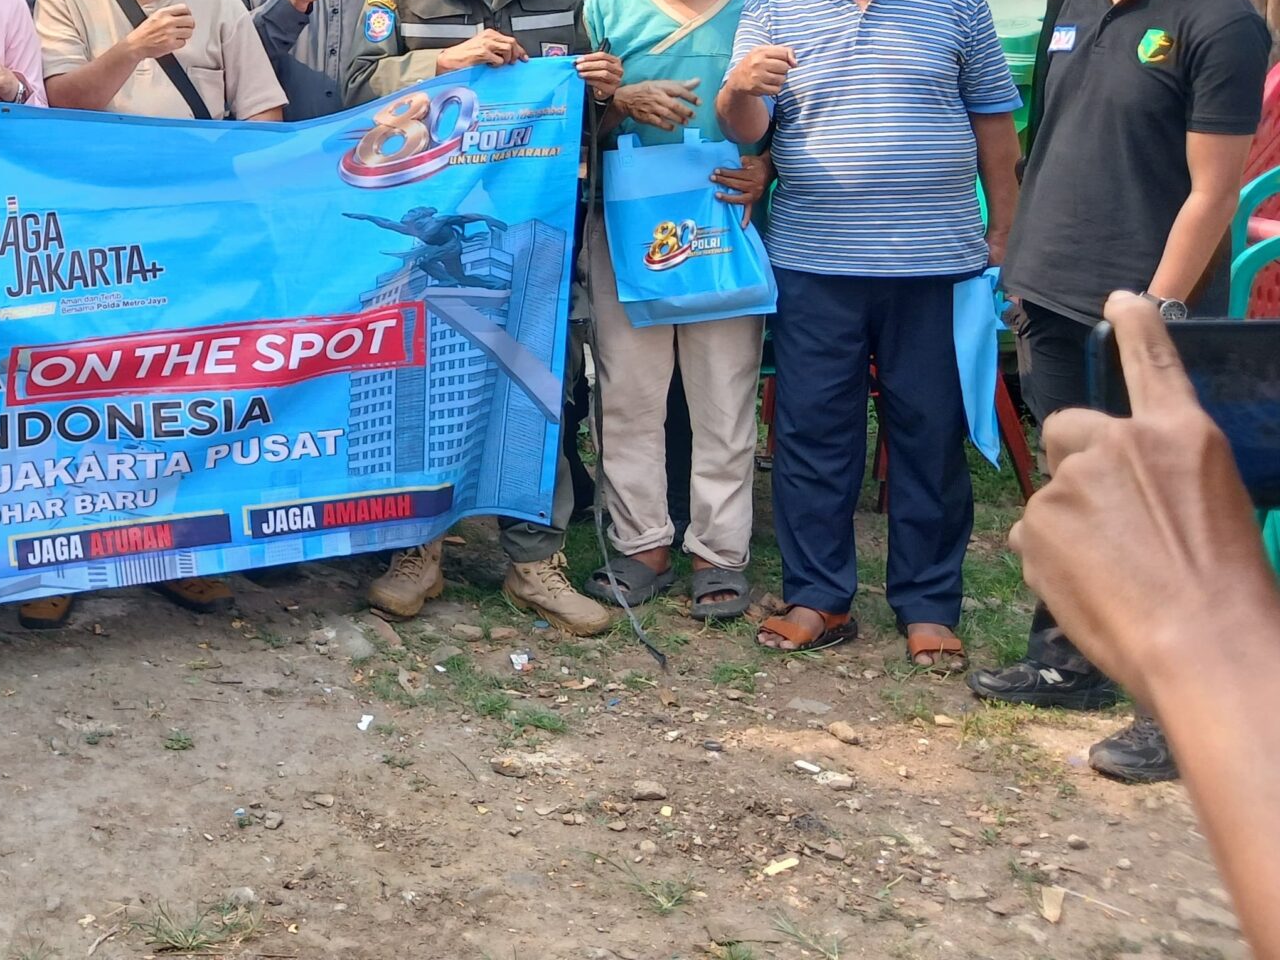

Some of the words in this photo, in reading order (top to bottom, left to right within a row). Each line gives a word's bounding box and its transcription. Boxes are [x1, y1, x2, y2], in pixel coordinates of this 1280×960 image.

[461, 125, 534, 154] POLRI
[448, 153, 488, 166] UNTUK
[691, 237, 721, 251] POLRI
[97, 302, 120, 311] Polda
[122, 300, 146, 308] Metro
[147, 297, 167, 306] Jaya
[29, 347, 124, 387] ON
[134, 336, 241, 379] THE
[252, 319, 398, 369] SPOT
[204, 428, 345, 470] PUSAT
[74, 488, 158, 516] BARU
[261, 505, 316, 535] JAGA
[322, 494, 412, 528] AMANAH
[27, 534, 84, 566] JAGA
[89, 523, 174, 560] ATURAN
